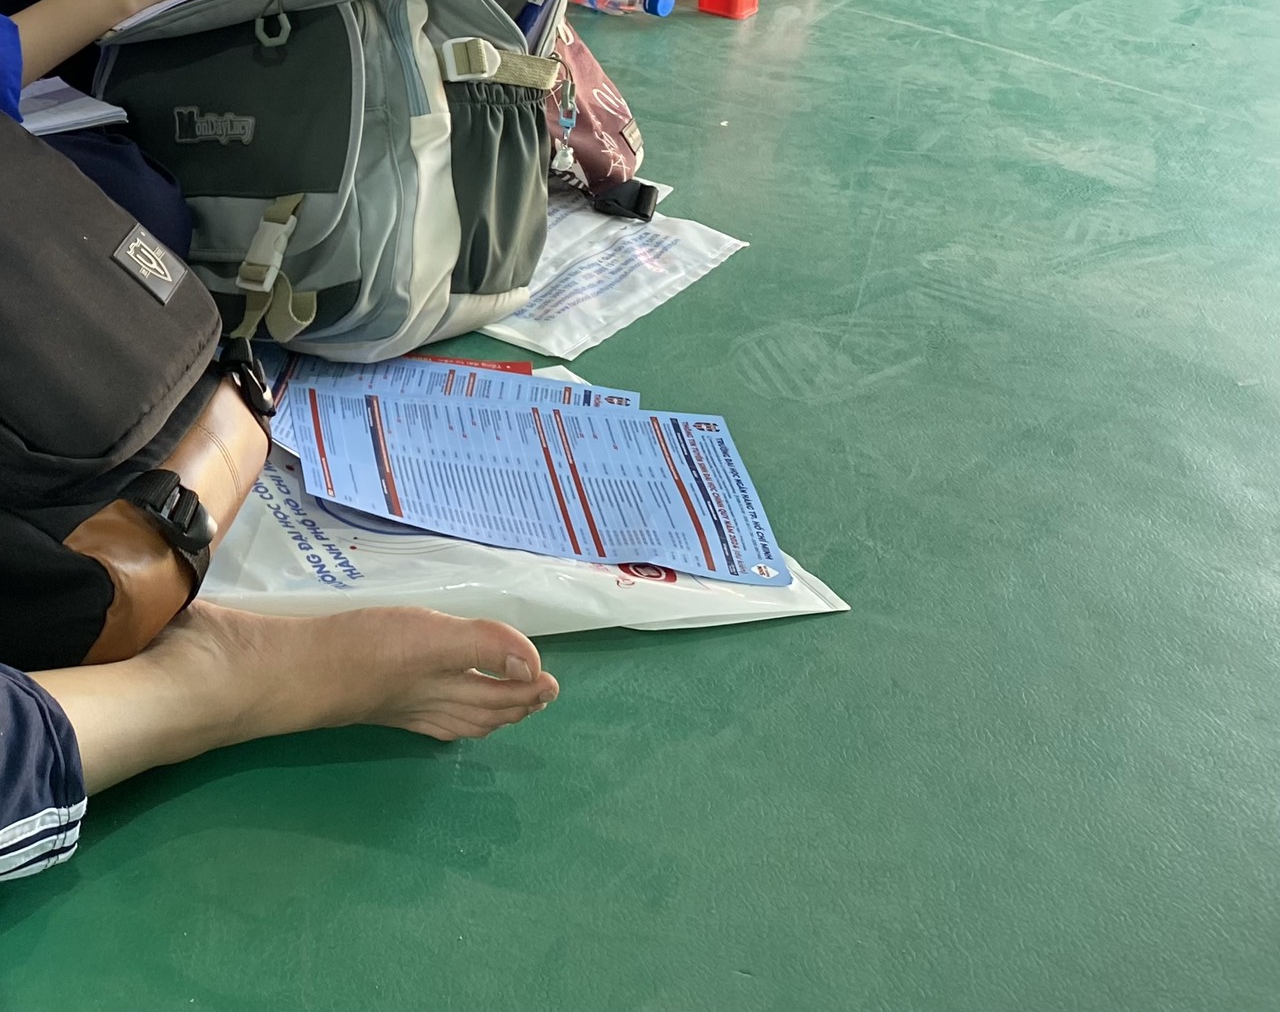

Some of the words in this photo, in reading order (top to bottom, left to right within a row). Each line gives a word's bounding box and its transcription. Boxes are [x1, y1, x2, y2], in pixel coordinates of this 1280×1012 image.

[270, 474, 291, 495] CHÍ
[267, 503, 295, 530] HỌC
[286, 498, 308, 518] HỒ
[727, 467, 740, 478] HỌC
[758, 542, 774, 560] MINH
[287, 530, 313, 552] ĐẠI
[300, 519, 332, 542] PHỐ
[322, 543, 364, 580] THÀNH
